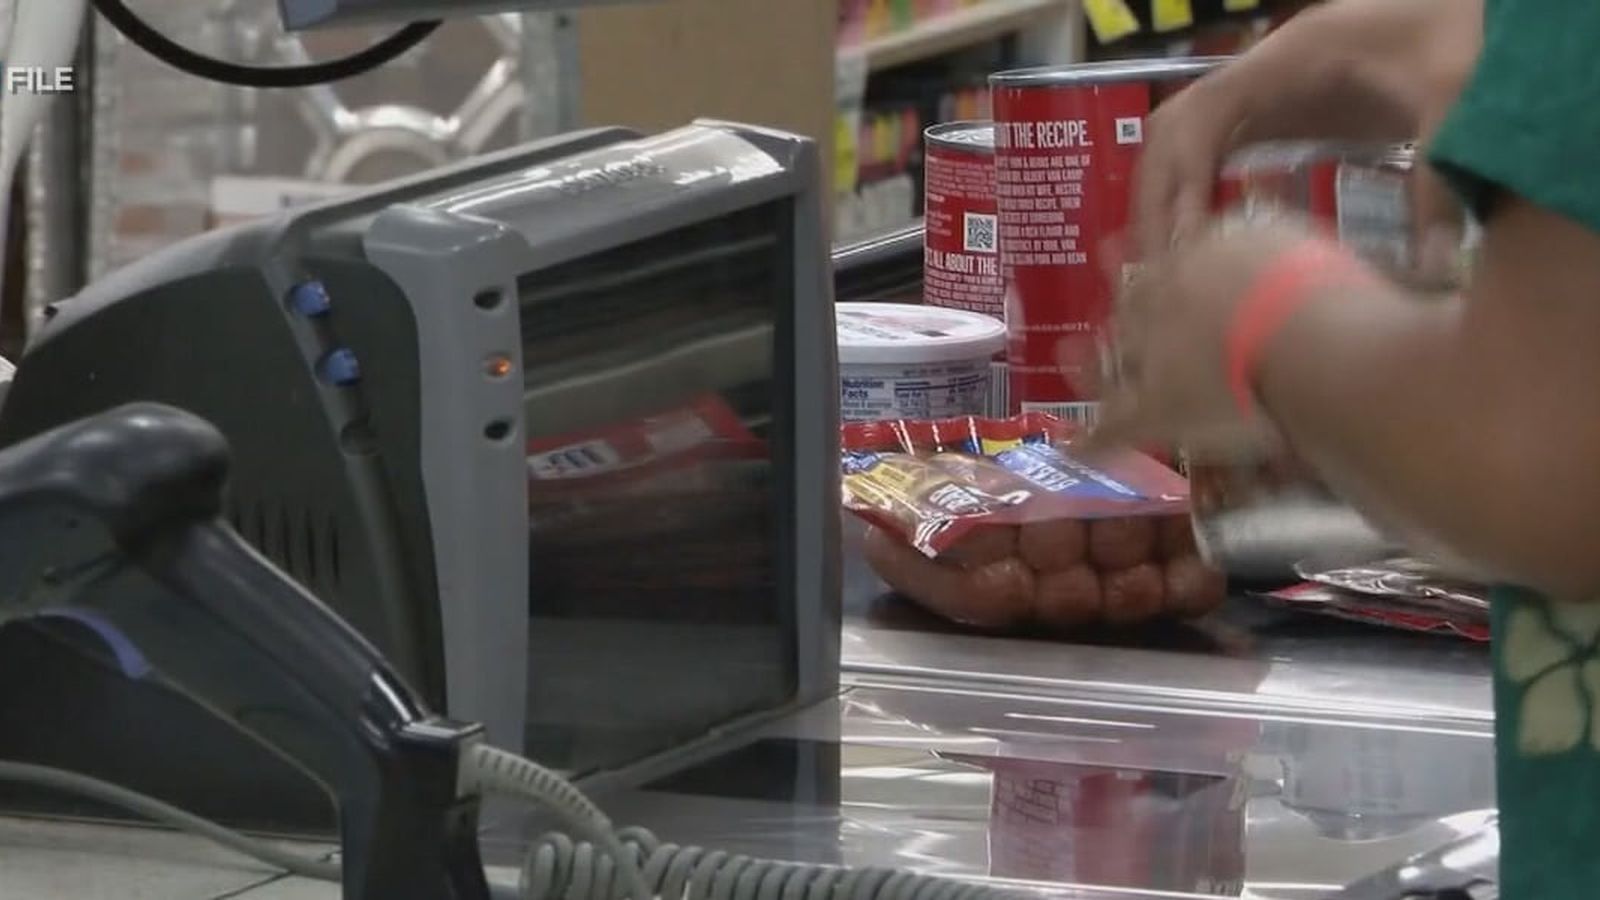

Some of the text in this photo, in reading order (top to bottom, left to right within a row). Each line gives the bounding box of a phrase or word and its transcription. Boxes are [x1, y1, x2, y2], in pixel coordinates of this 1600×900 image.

[1012, 122, 1035, 148] THE
[1036, 119, 1094, 148] RECIPE.
[945, 252, 975, 274] ABOUT
[976, 255, 998, 276] THE
[842, 389, 869, 400] Facts
